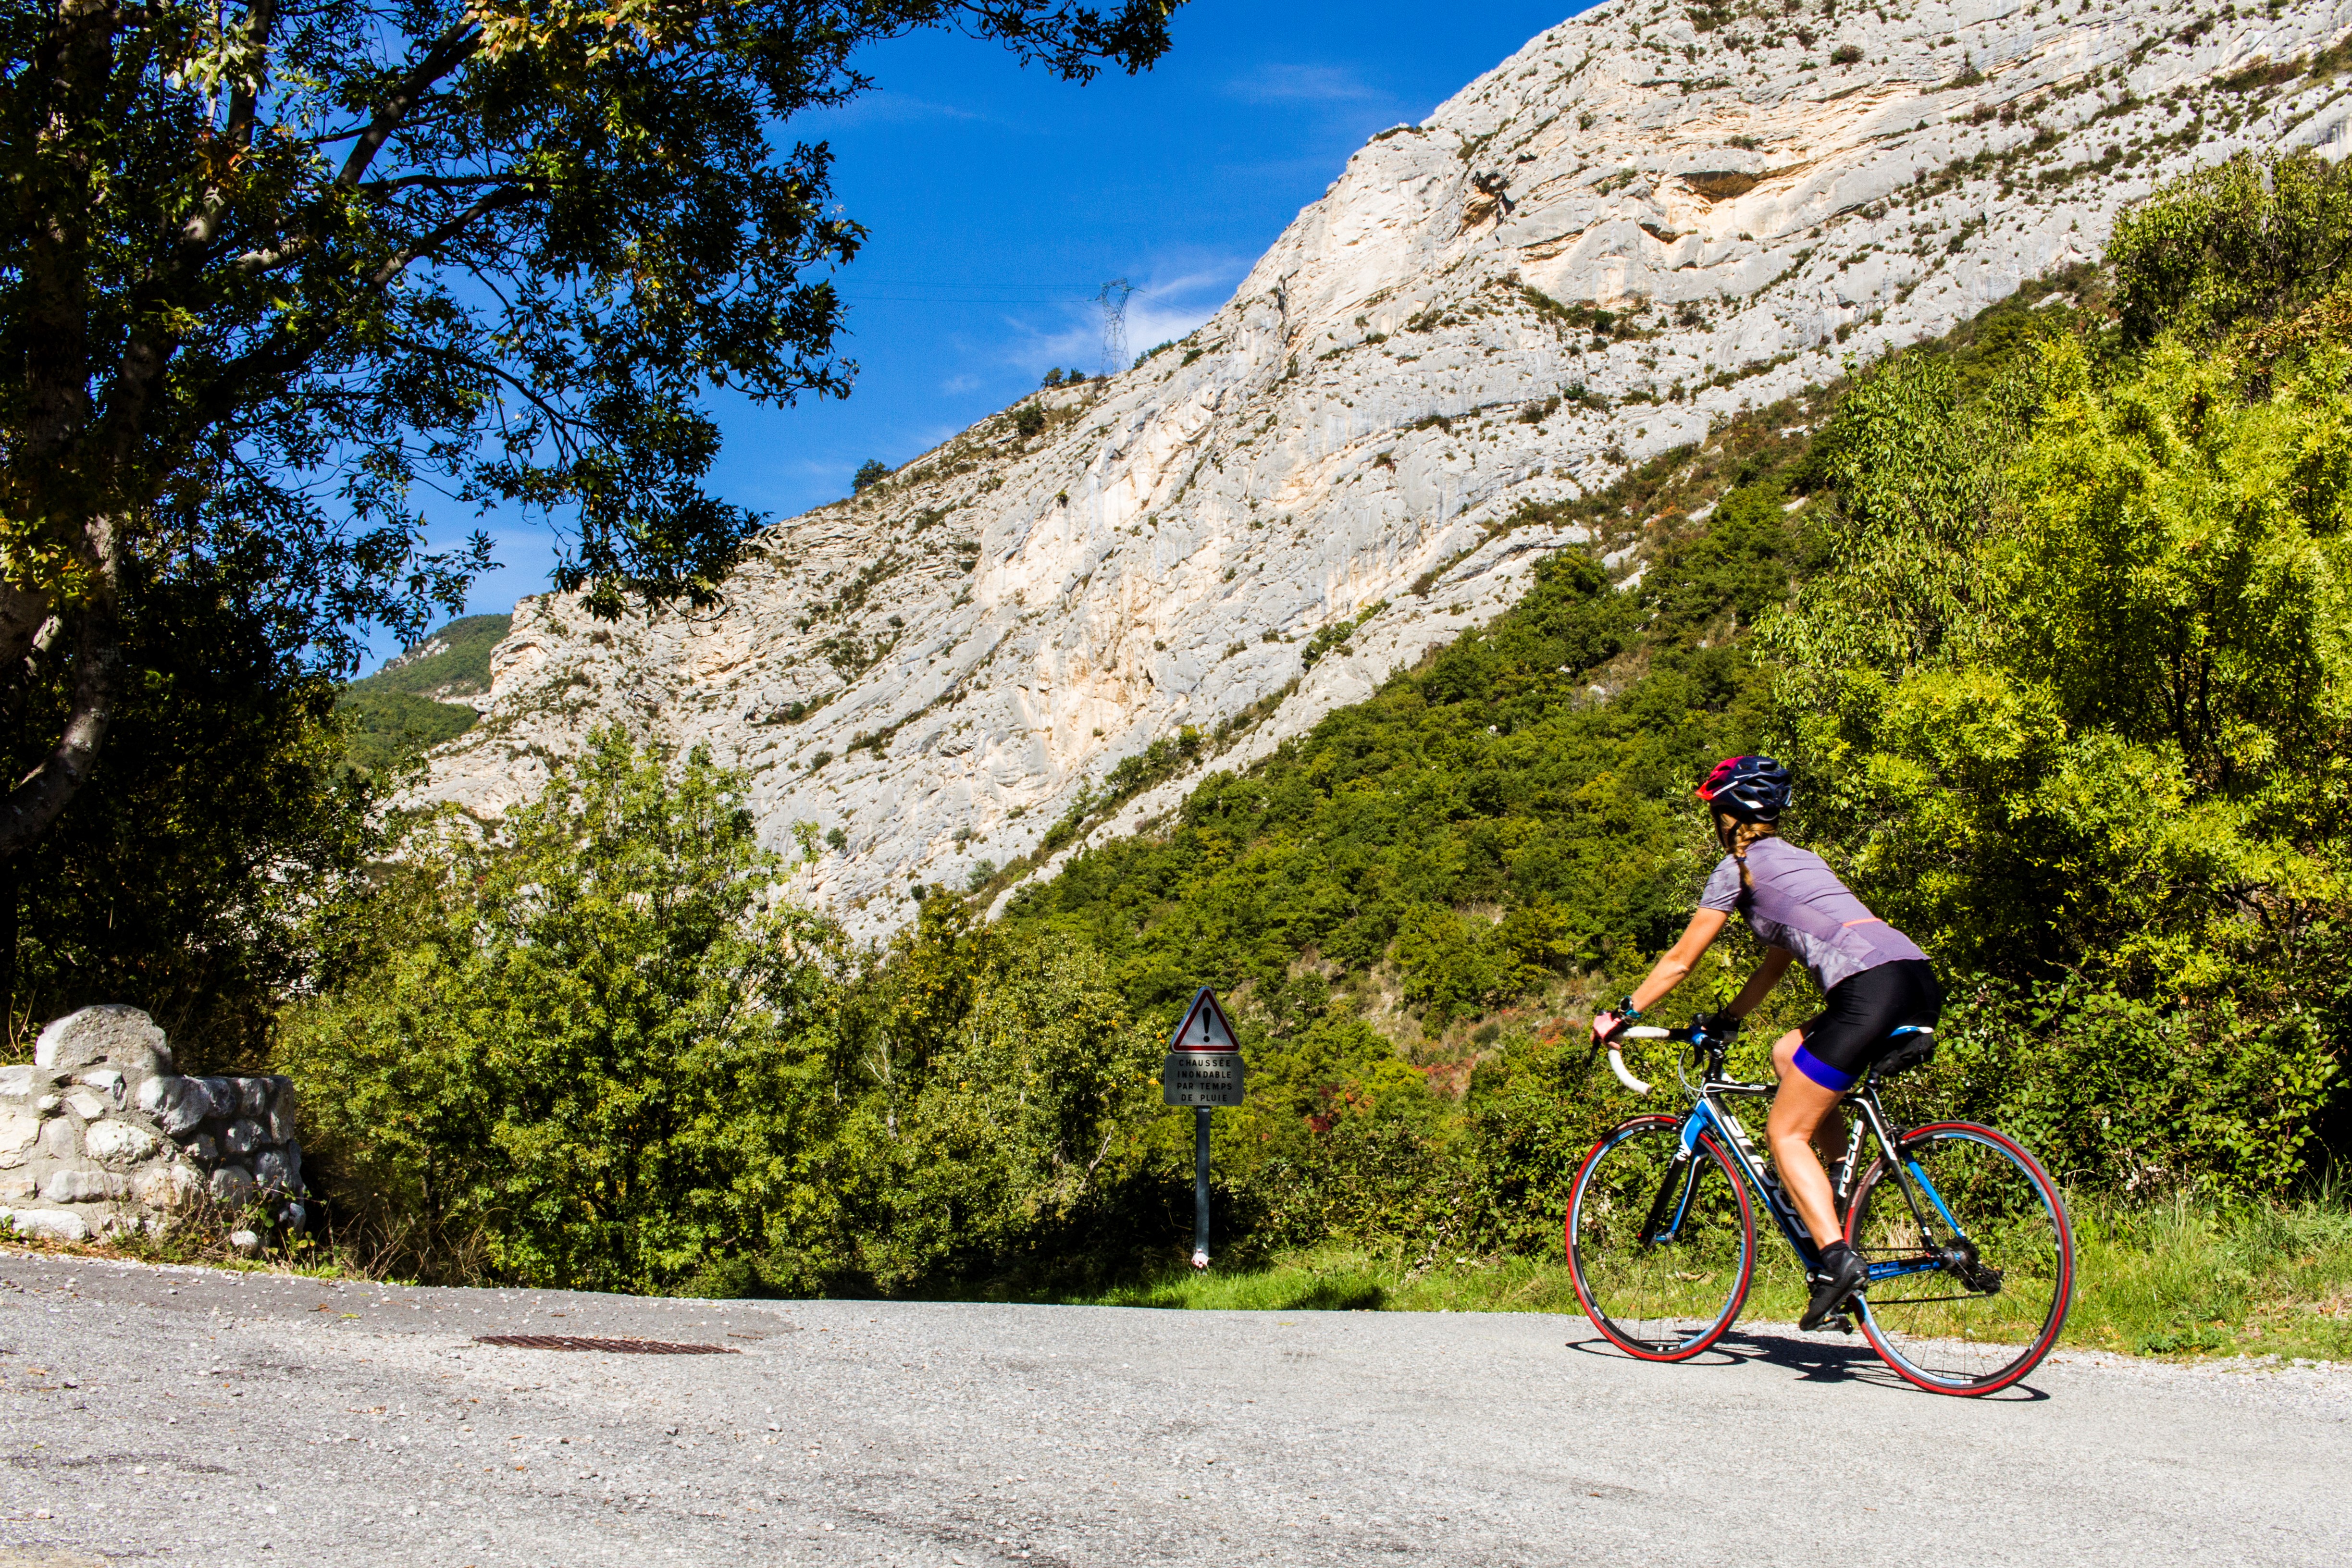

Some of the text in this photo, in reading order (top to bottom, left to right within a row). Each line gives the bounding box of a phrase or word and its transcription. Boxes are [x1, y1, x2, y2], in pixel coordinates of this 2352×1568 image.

[1179, 1058, 1231, 1066] CHAUSSÉE
[1838, 1119, 1864, 1198] FOCUS
[1869, 1261, 1900, 1271] CUS
